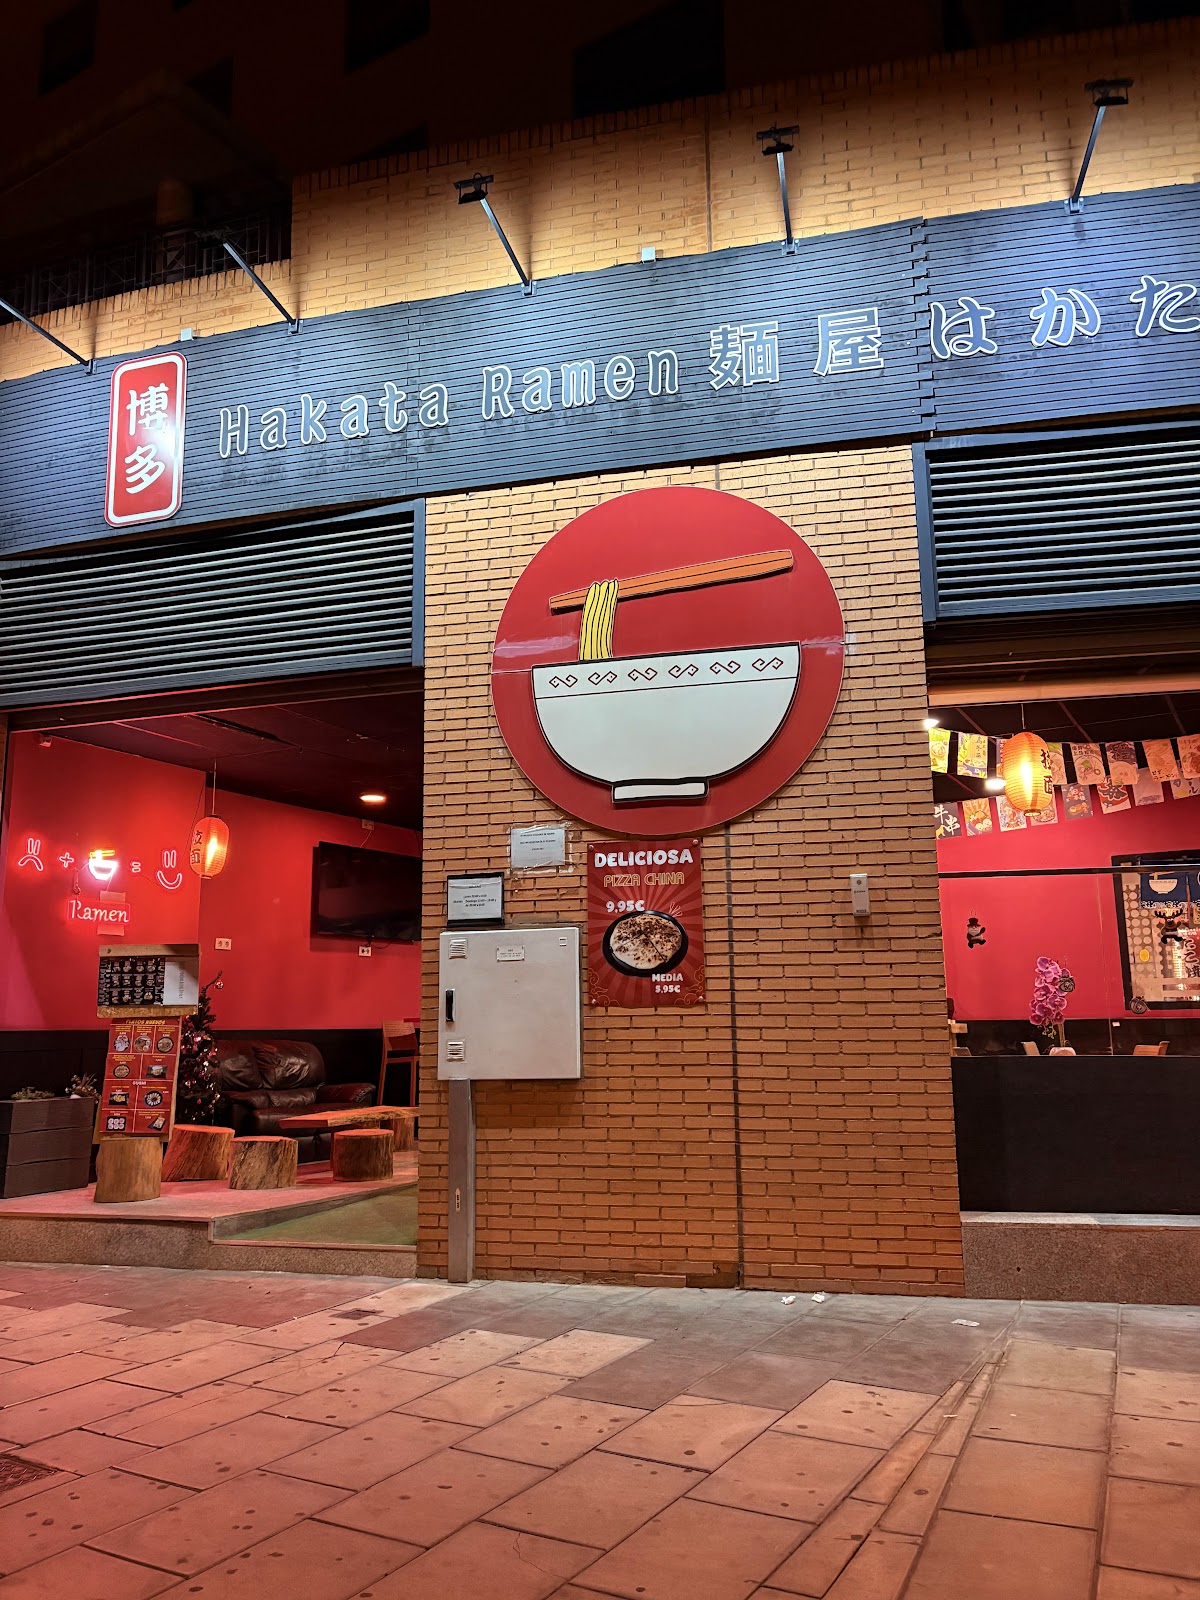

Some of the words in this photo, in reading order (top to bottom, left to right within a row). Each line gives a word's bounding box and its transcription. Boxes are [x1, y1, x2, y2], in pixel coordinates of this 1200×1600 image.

[218, 381, 450, 460] Hakata
[481, 348, 681, 422] Ramen
[125, 382, 170, 495] 博多
[594, 848, 694, 868] DELICIOSA
[603, 873, 641, 888] PIZZA
[643, 871, 685, 886] CHINA
[69, 899, 129, 923] Ramen
[651, 973, 684, 983] MEDIA
